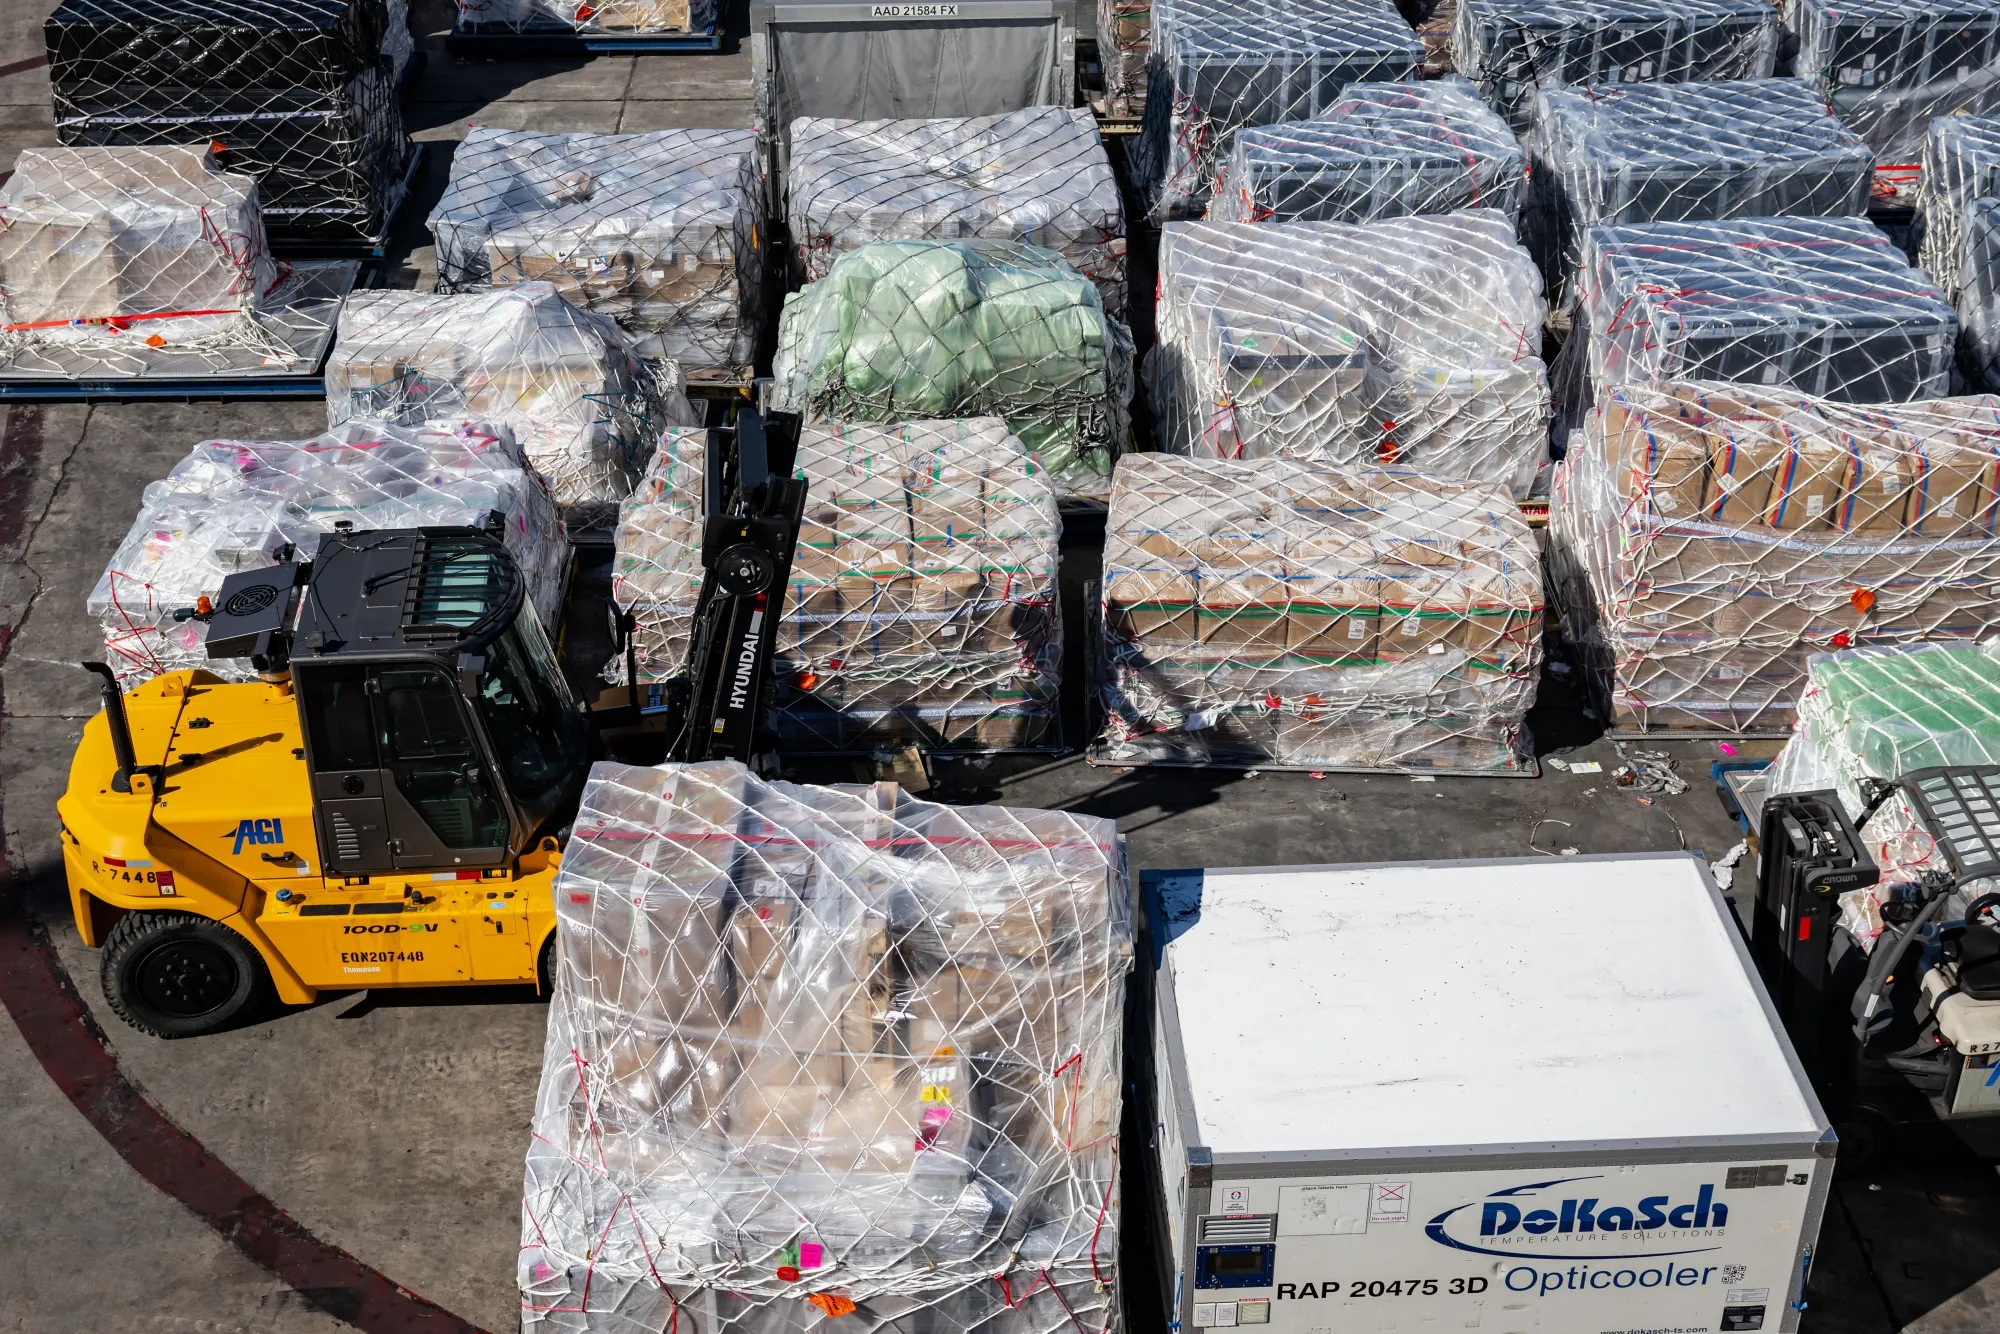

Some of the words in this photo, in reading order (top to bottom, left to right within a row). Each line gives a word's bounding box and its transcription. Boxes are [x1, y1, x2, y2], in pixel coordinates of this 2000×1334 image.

[874, 6, 900, 16] AAD
[903, 5, 937, 16] 21584
[940, 5, 956, 15] FX
[729, 632, 760, 710] HYUNDAI
[231, 817, 284, 855] AGI
[92, 859, 157, 884] R-7448
[343, 923, 439, 935] 100D-9V
[341, 950, 424, 963] EQN207448
[1479, 1184, 1729, 1236] DoKaSch
[1479, 1234, 1608, 1245] TEMPERATURE
[1621, 1229, 1726, 1240] SOLUTIONS
[1277, 1281, 1340, 1300] RAP
[1349, 1279, 1438, 1298] 20475
[1448, 1276, 1489, 1295] 3D
[1504, 1262, 1718, 1297] Opticooler
